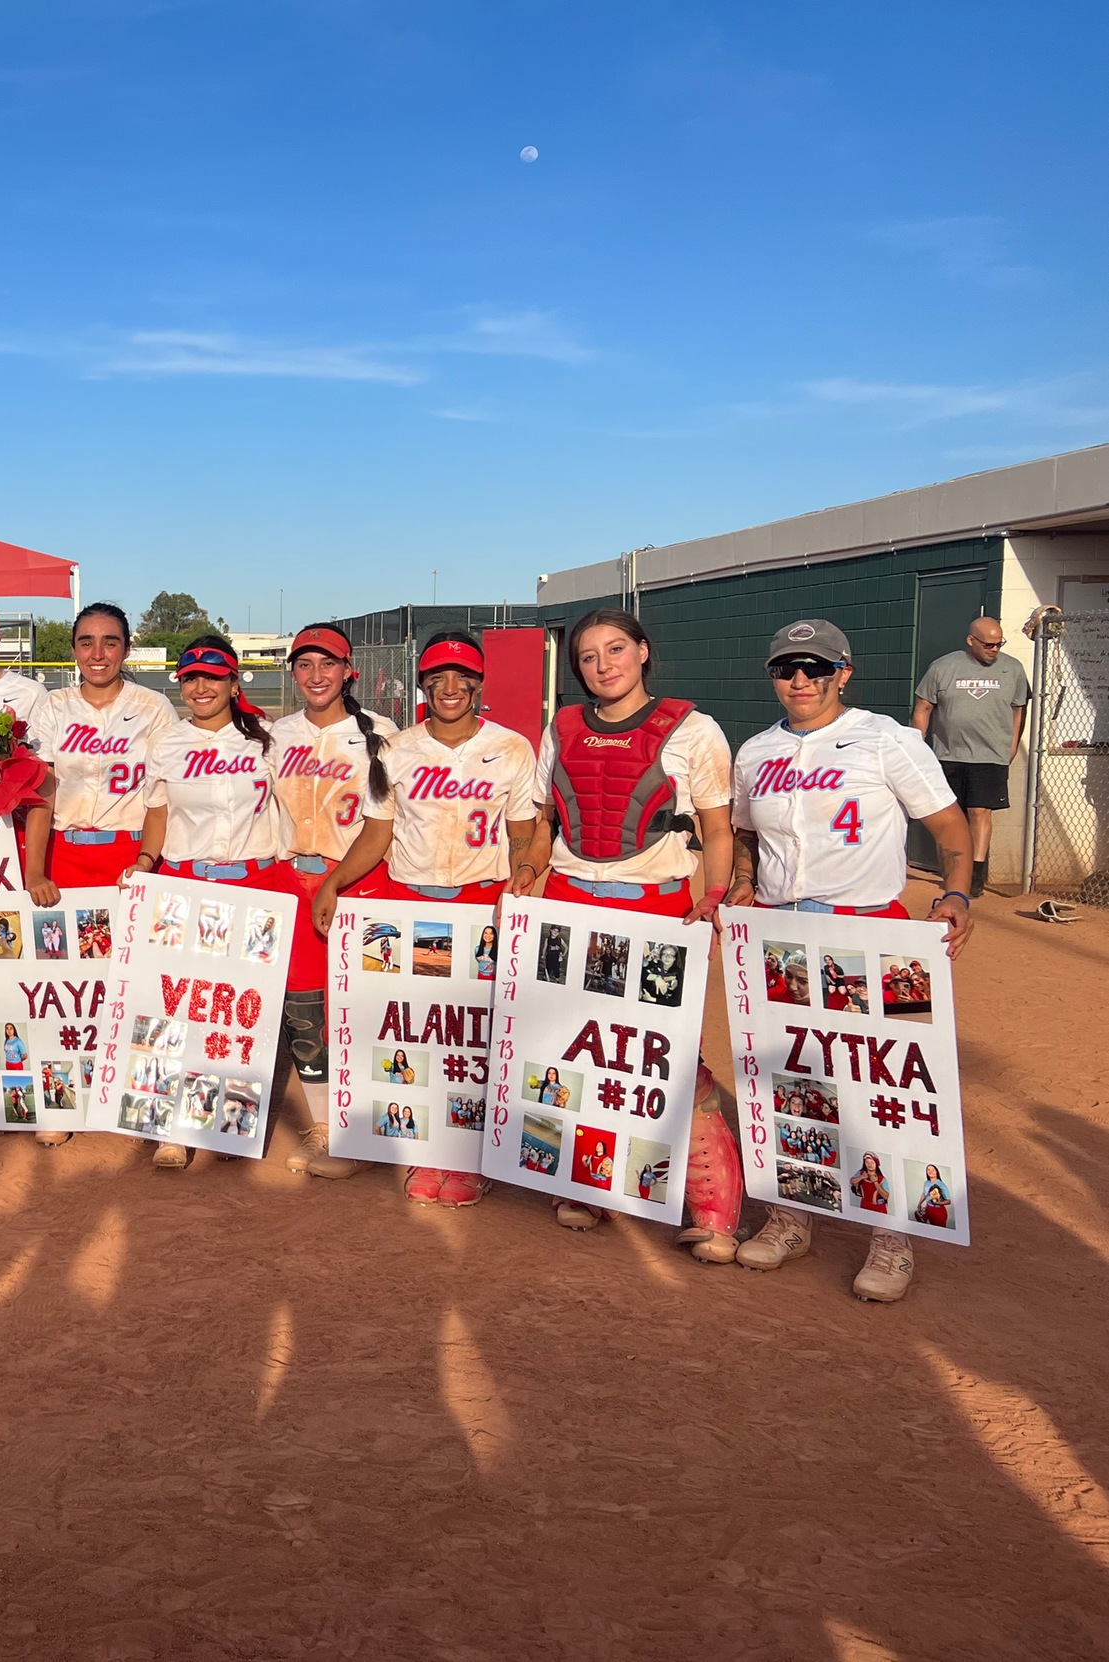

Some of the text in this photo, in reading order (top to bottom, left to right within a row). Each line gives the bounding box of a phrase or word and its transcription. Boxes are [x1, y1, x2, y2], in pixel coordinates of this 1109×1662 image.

[59, 722, 129, 755] Mesa
[583, 736, 632, 749] Diamond
[108, 762, 147, 798] 20
[183, 748, 259, 780] Mesa
[278, 745, 353, 783] Mesa
[407, 765, 494, 801] Mesa
[753, 757, 845, 797] Mesa
[252, 779, 269, 815] 7
[335, 793, 361, 829] 3
[830, 797, 864, 846] 4
[119, 884, 146, 964] MESA
[336, 912, 356, 993] MESA
[503, 913, 529, 1001] MESA
[727, 922, 750, 1015] MESA
[18, 980, 106, 1019] YAYA
[160, 974, 263, 1030] VERO
[59, 1024, 98, 1051] #2
[377, 1000, 494, 1049] ALANI
[203, 1031, 255, 1066] #7
[561, 1019, 671, 1082] AIR
[784, 1025, 937, 1094] ZYTKA
[443, 1053, 490, 1085] #3
[597, 1077, 667, 1120] #10
[870, 1094, 940, 1137] #4
